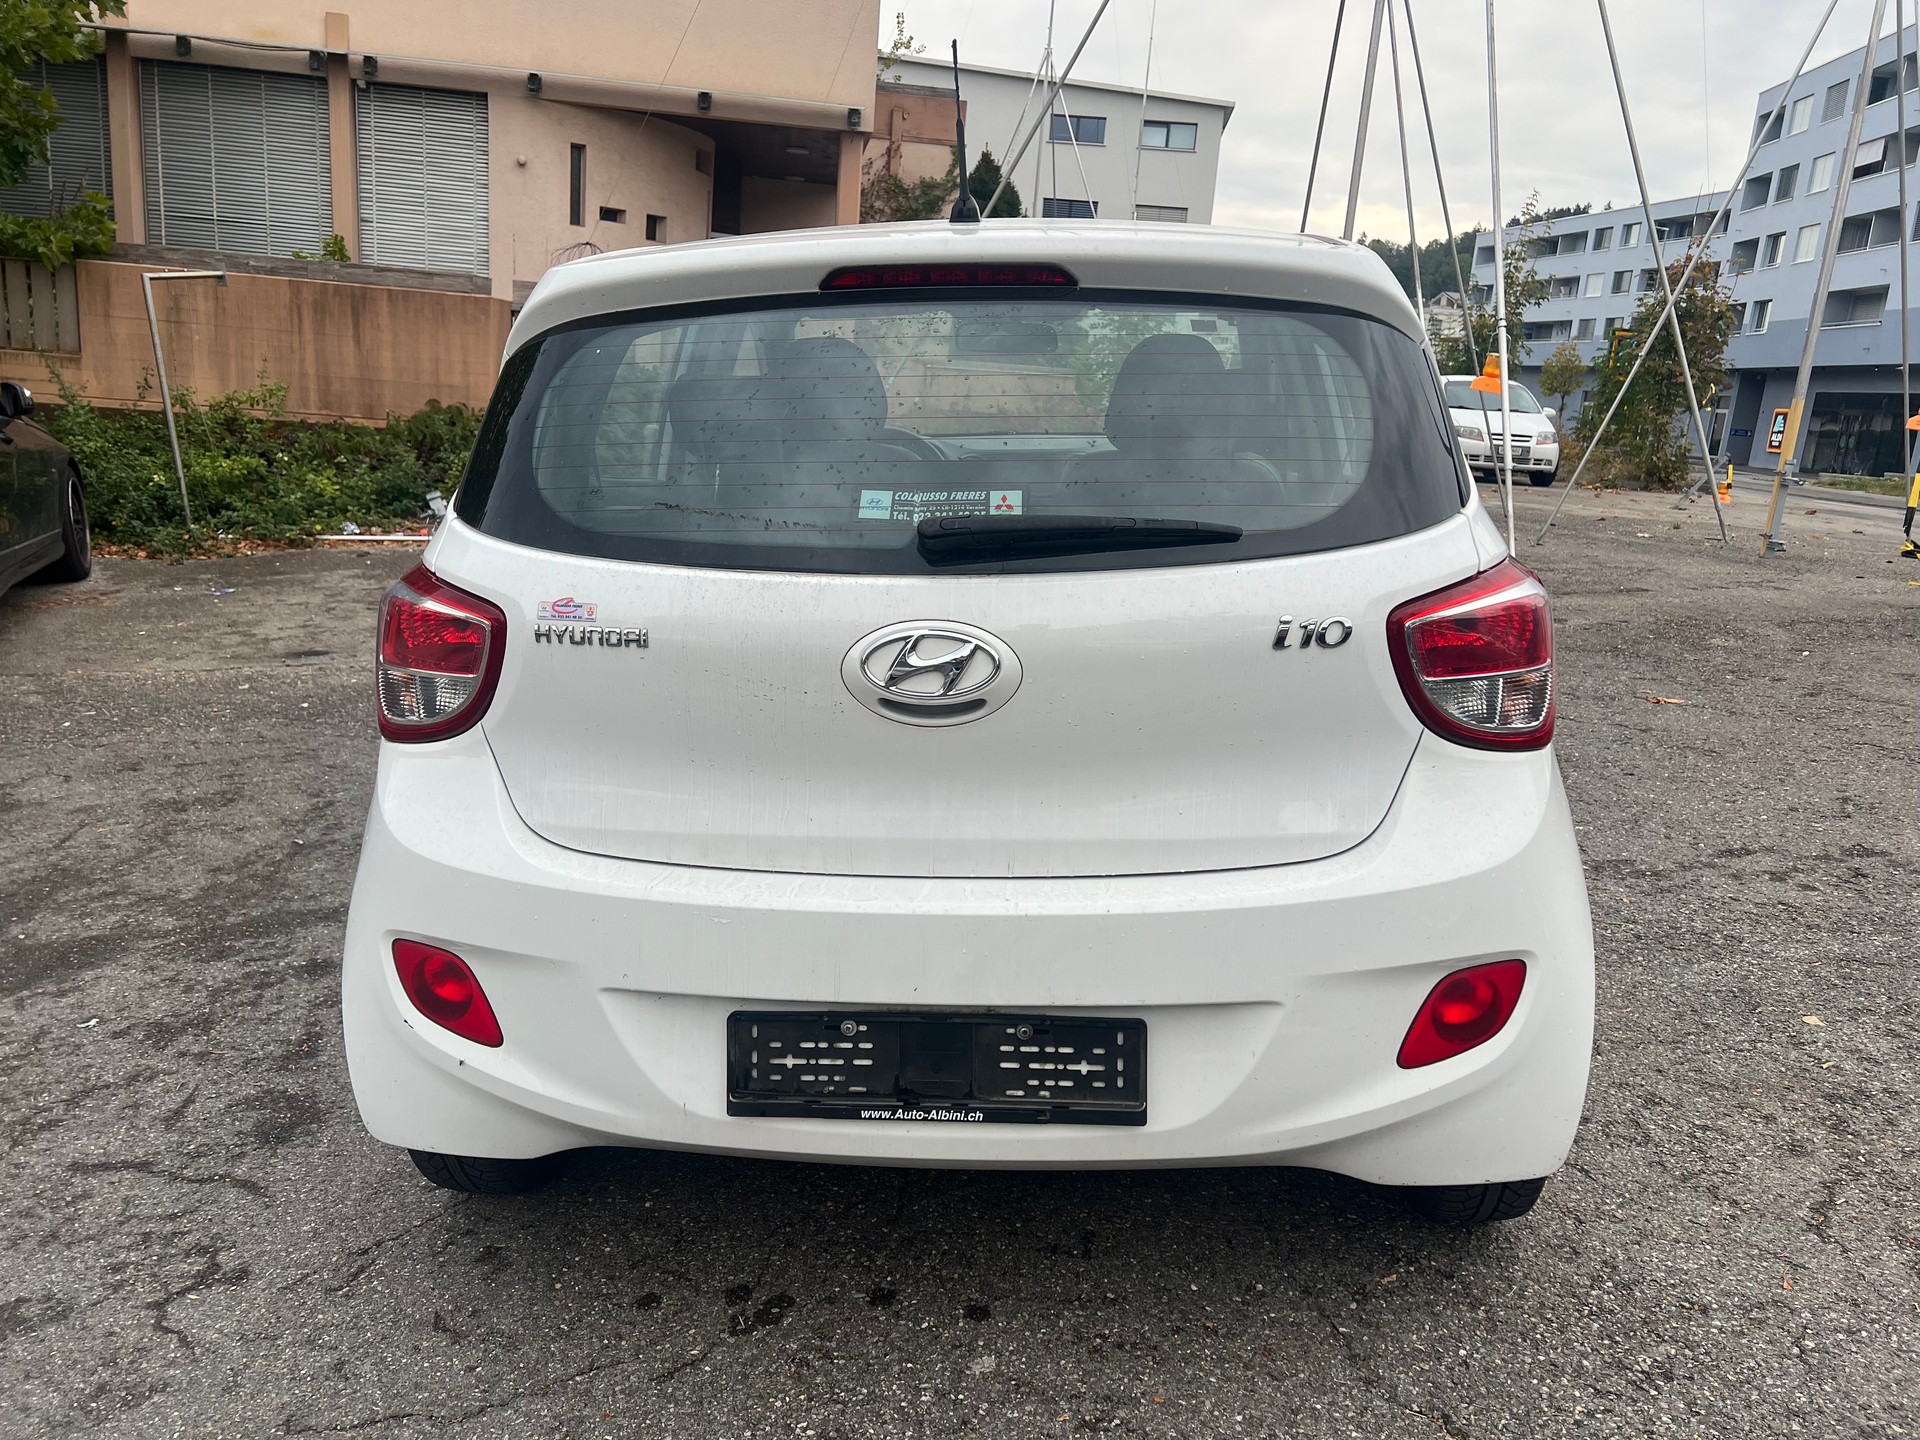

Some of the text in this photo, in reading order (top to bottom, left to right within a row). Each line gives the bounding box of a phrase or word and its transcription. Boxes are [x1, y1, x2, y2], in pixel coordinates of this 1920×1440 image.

[950, 491, 987, 500] FRERES
[893, 511, 910, 520] Tél.
[534, 623, 649, 649] HYUNDAI
[1272, 614, 1353, 651] i10
[861, 1109, 984, 1121] www.Auto-Albini.ch
